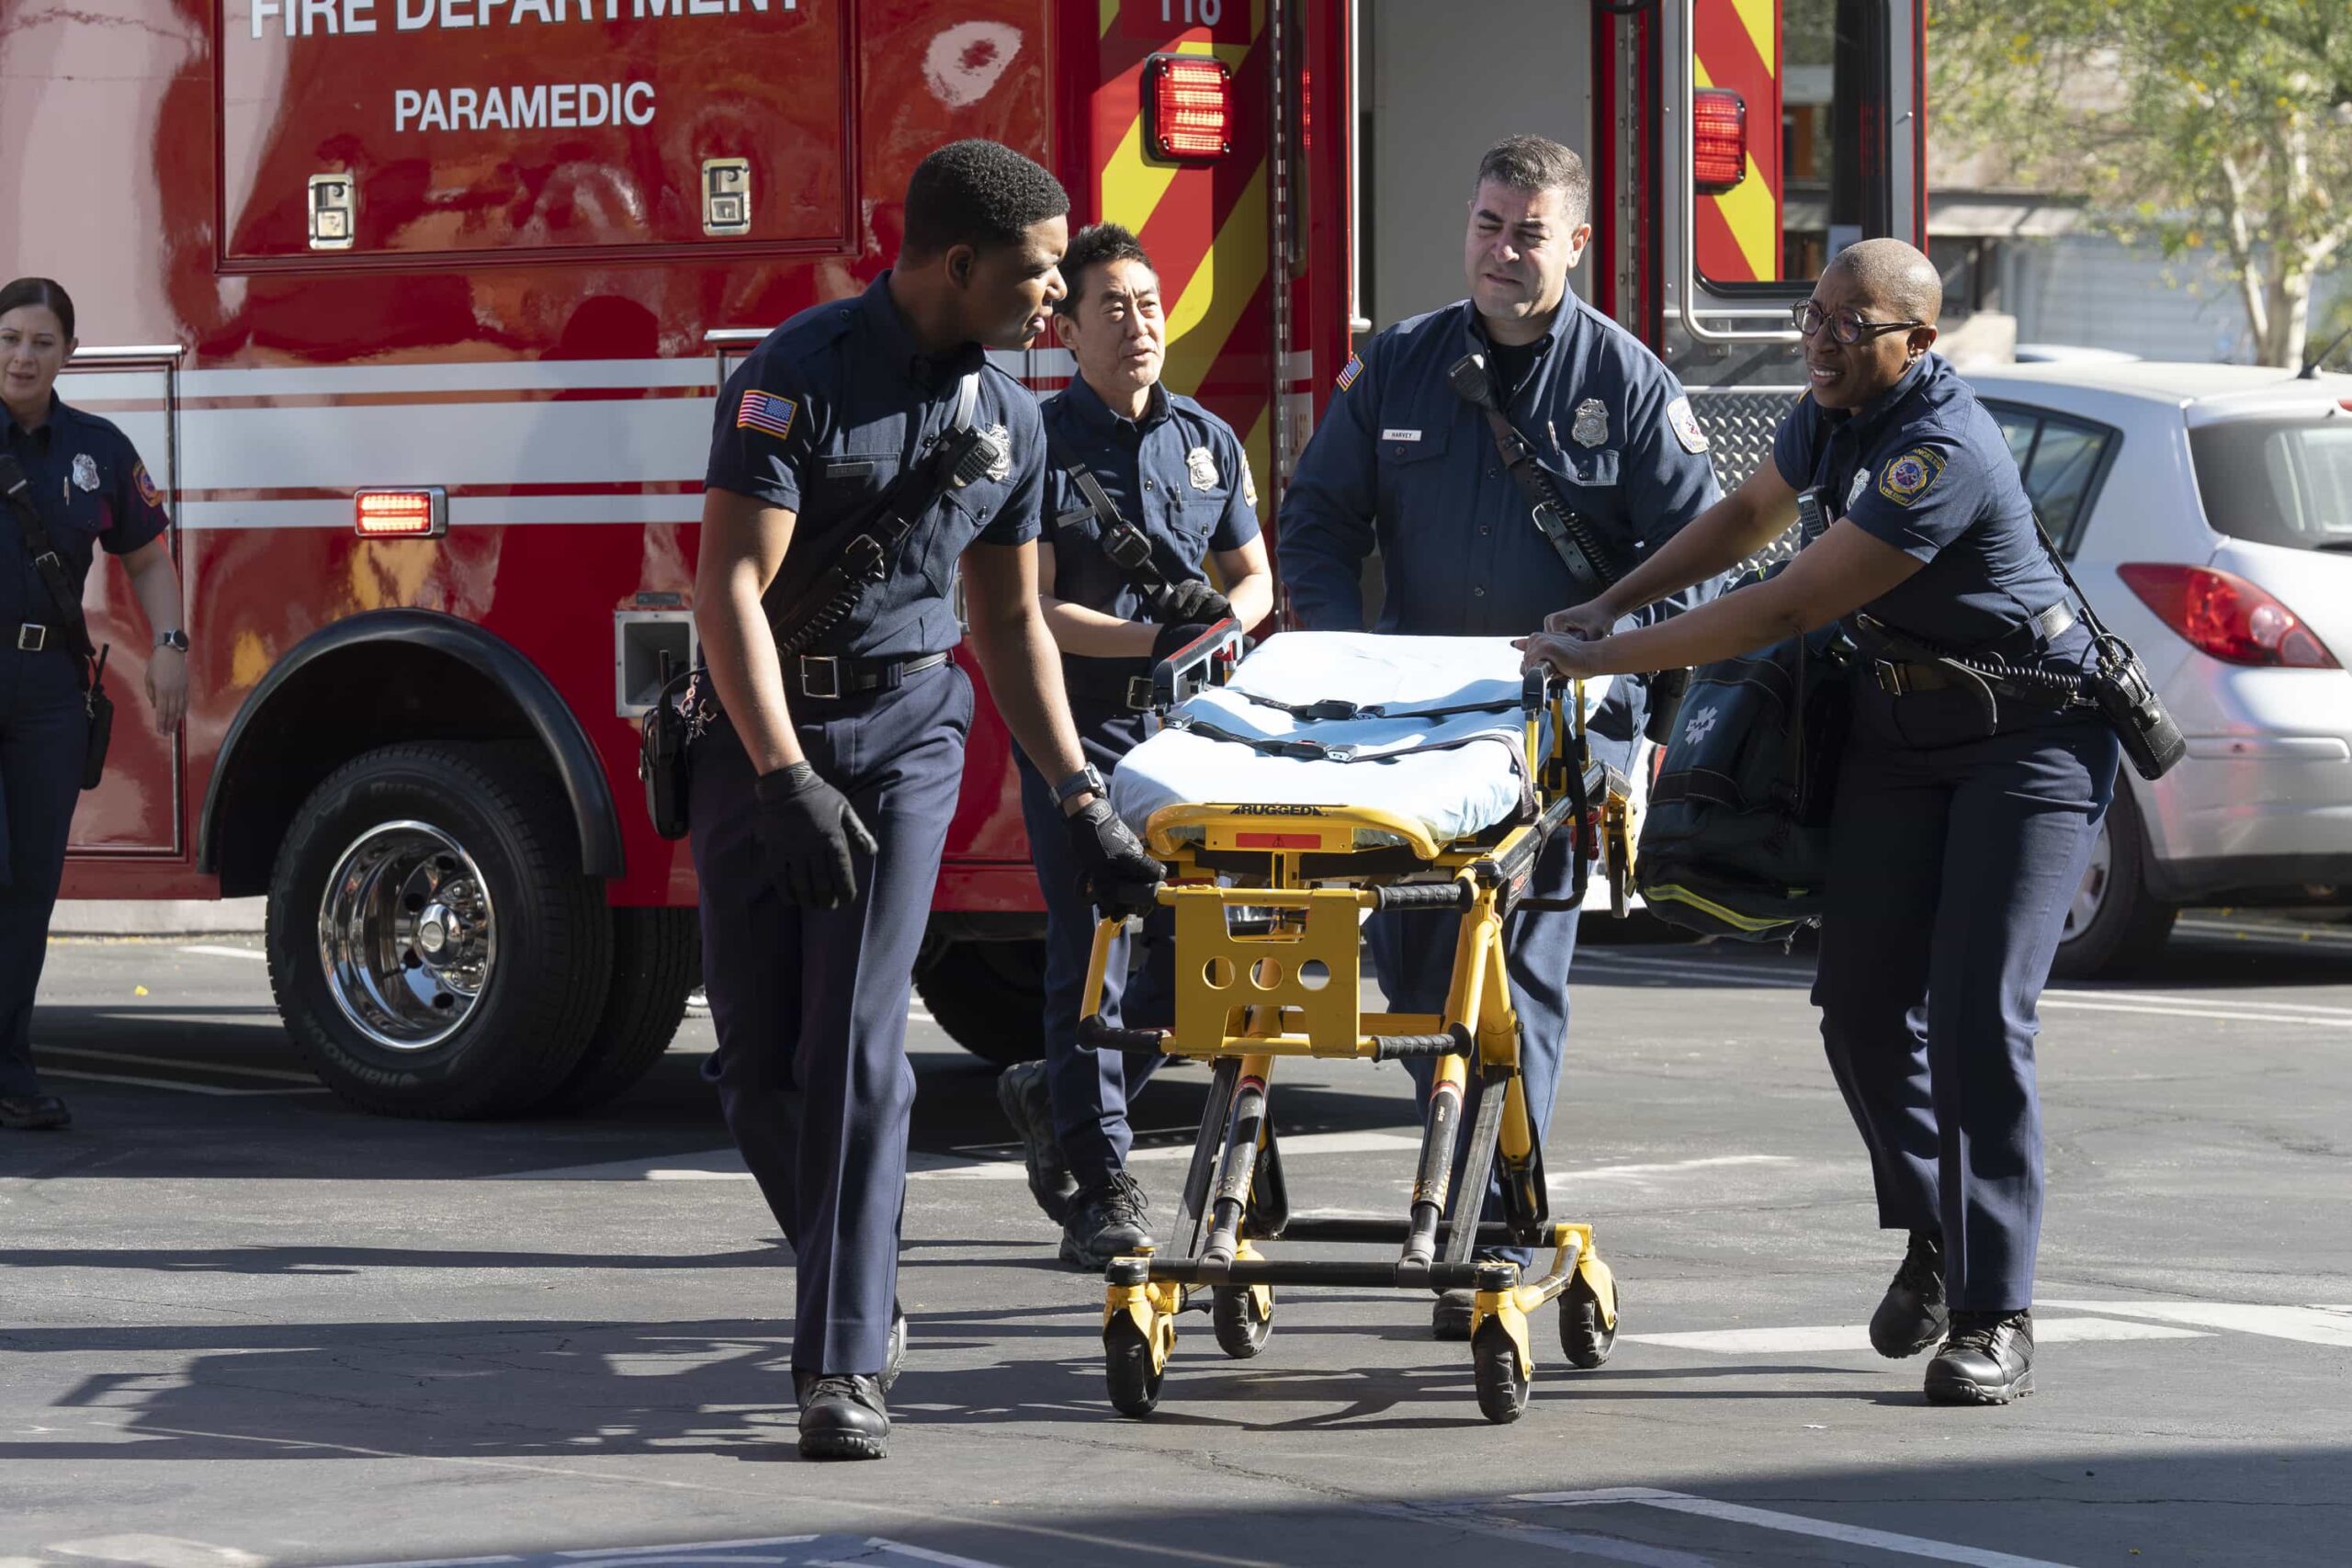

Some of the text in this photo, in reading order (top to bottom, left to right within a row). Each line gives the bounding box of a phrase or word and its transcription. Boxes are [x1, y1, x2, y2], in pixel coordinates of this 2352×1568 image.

[251, 0, 797, 39] FIRE DEPAR
[395, 81, 655, 131] PARAMEDIC
[1238, 804, 1312, 817] RUGGED
